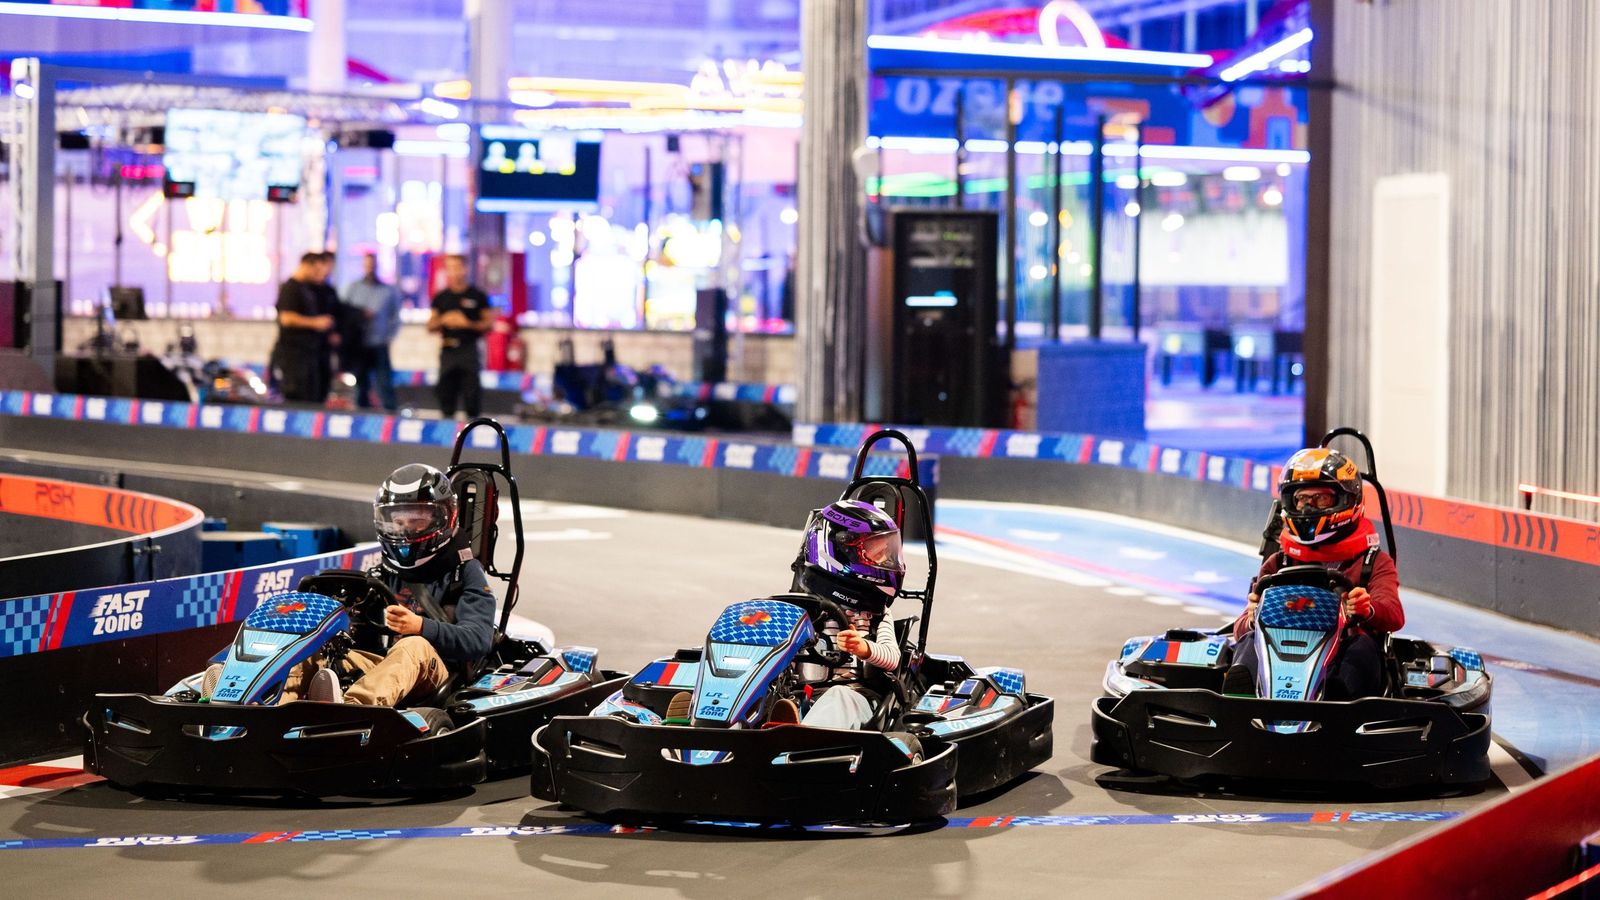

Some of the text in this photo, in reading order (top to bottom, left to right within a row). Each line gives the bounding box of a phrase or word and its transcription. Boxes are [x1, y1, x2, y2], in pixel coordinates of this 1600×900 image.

[36, 483, 75, 507] PGK
[253, 568, 294, 593] FAST
[88, 589, 150, 618] FAST
[93, 612, 143, 635] zone
[217, 687, 244, 695] FAST
[700, 705, 729, 713] FAST
